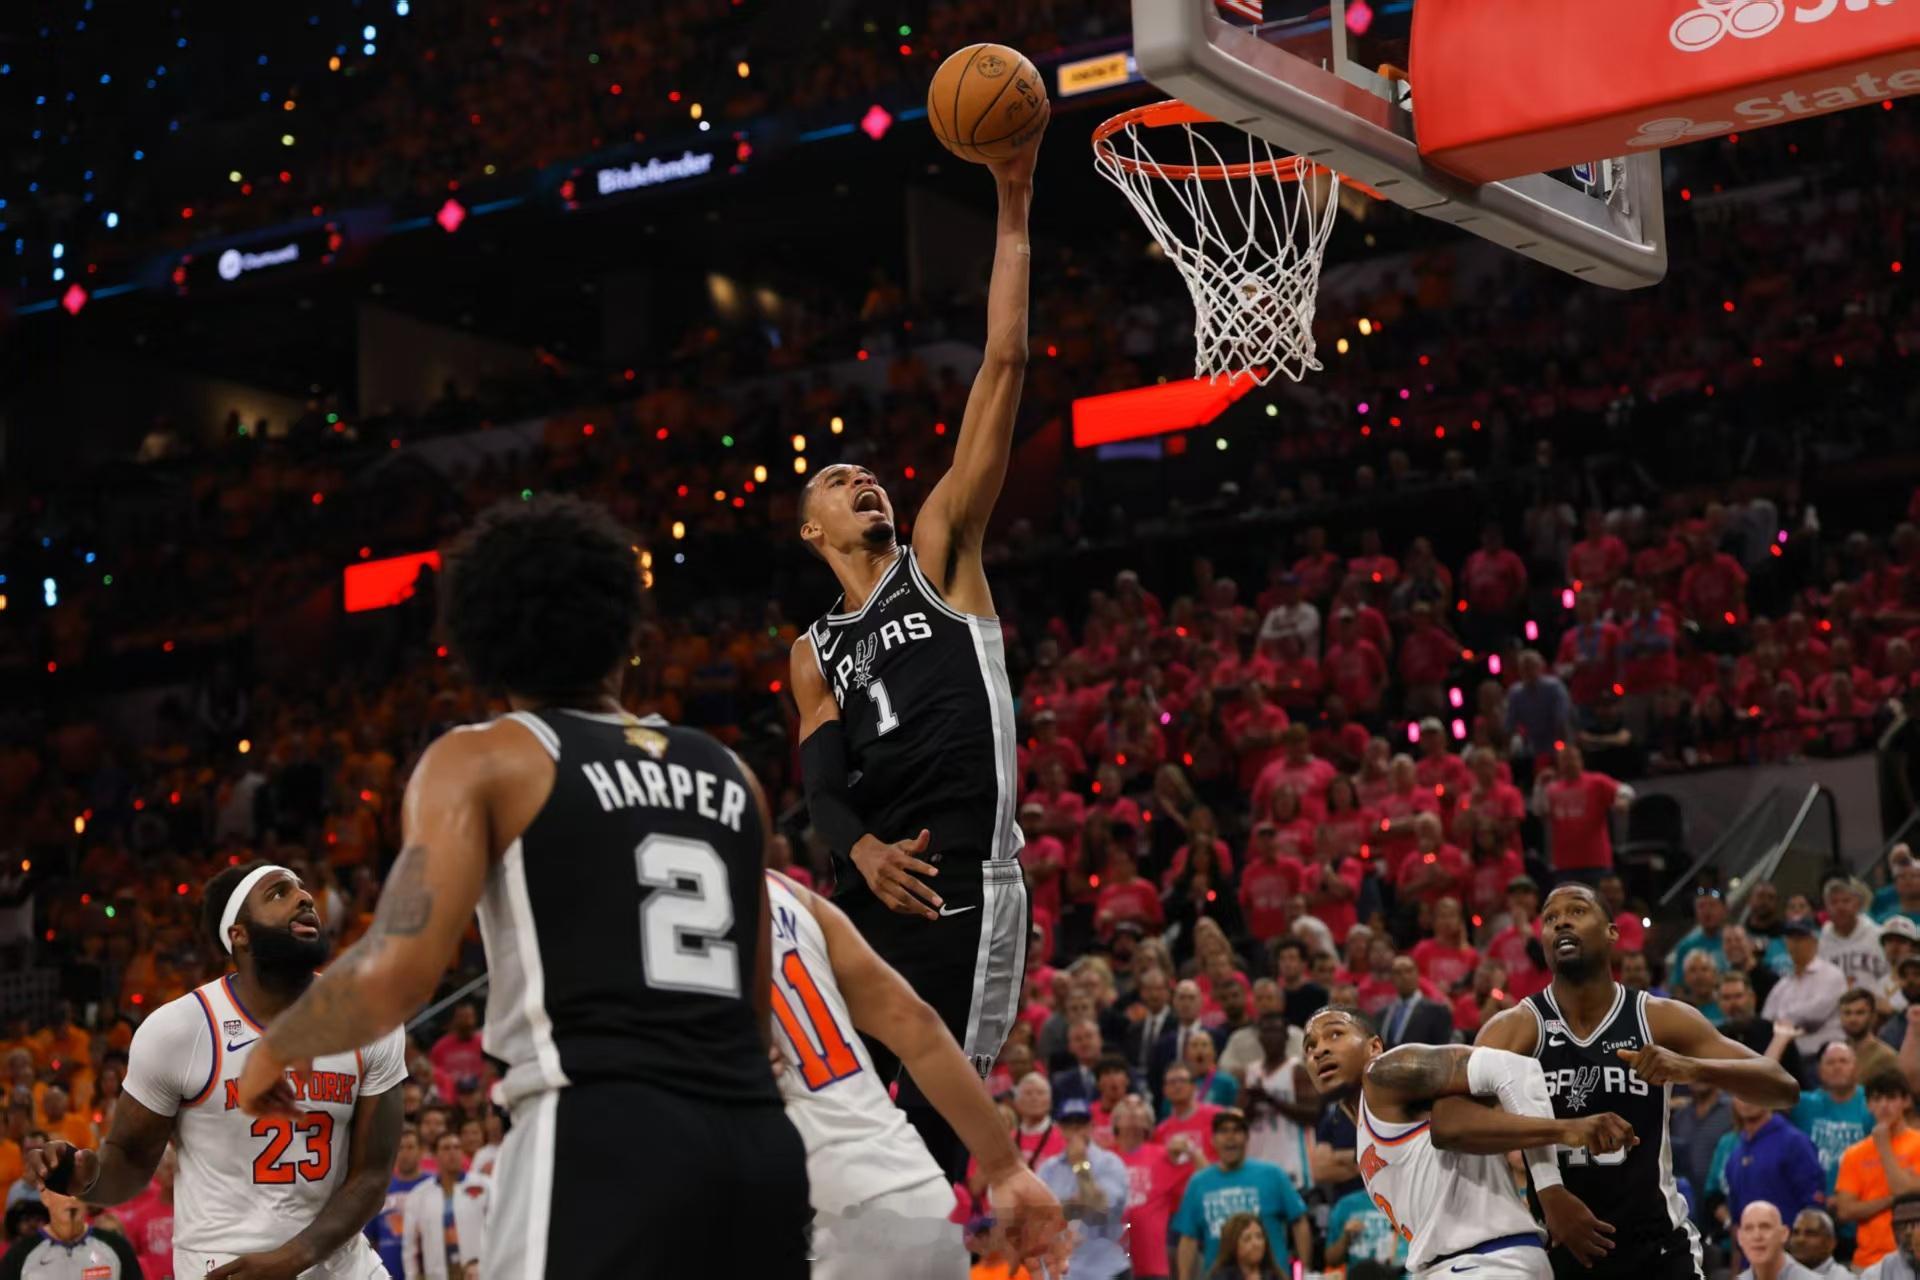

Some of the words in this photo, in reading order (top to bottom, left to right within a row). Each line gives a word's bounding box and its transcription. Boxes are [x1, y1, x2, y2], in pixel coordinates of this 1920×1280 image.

[1734, 69, 1920, 124] State
[867, 678, 900, 737] 1
[582, 760, 747, 832] HARPER
[634, 832, 741, 998] 2
[1604, 1038, 1635, 1051] LEDGER
[288, 1071, 357, 1104] YORK
[251, 1111, 334, 1184] 23
